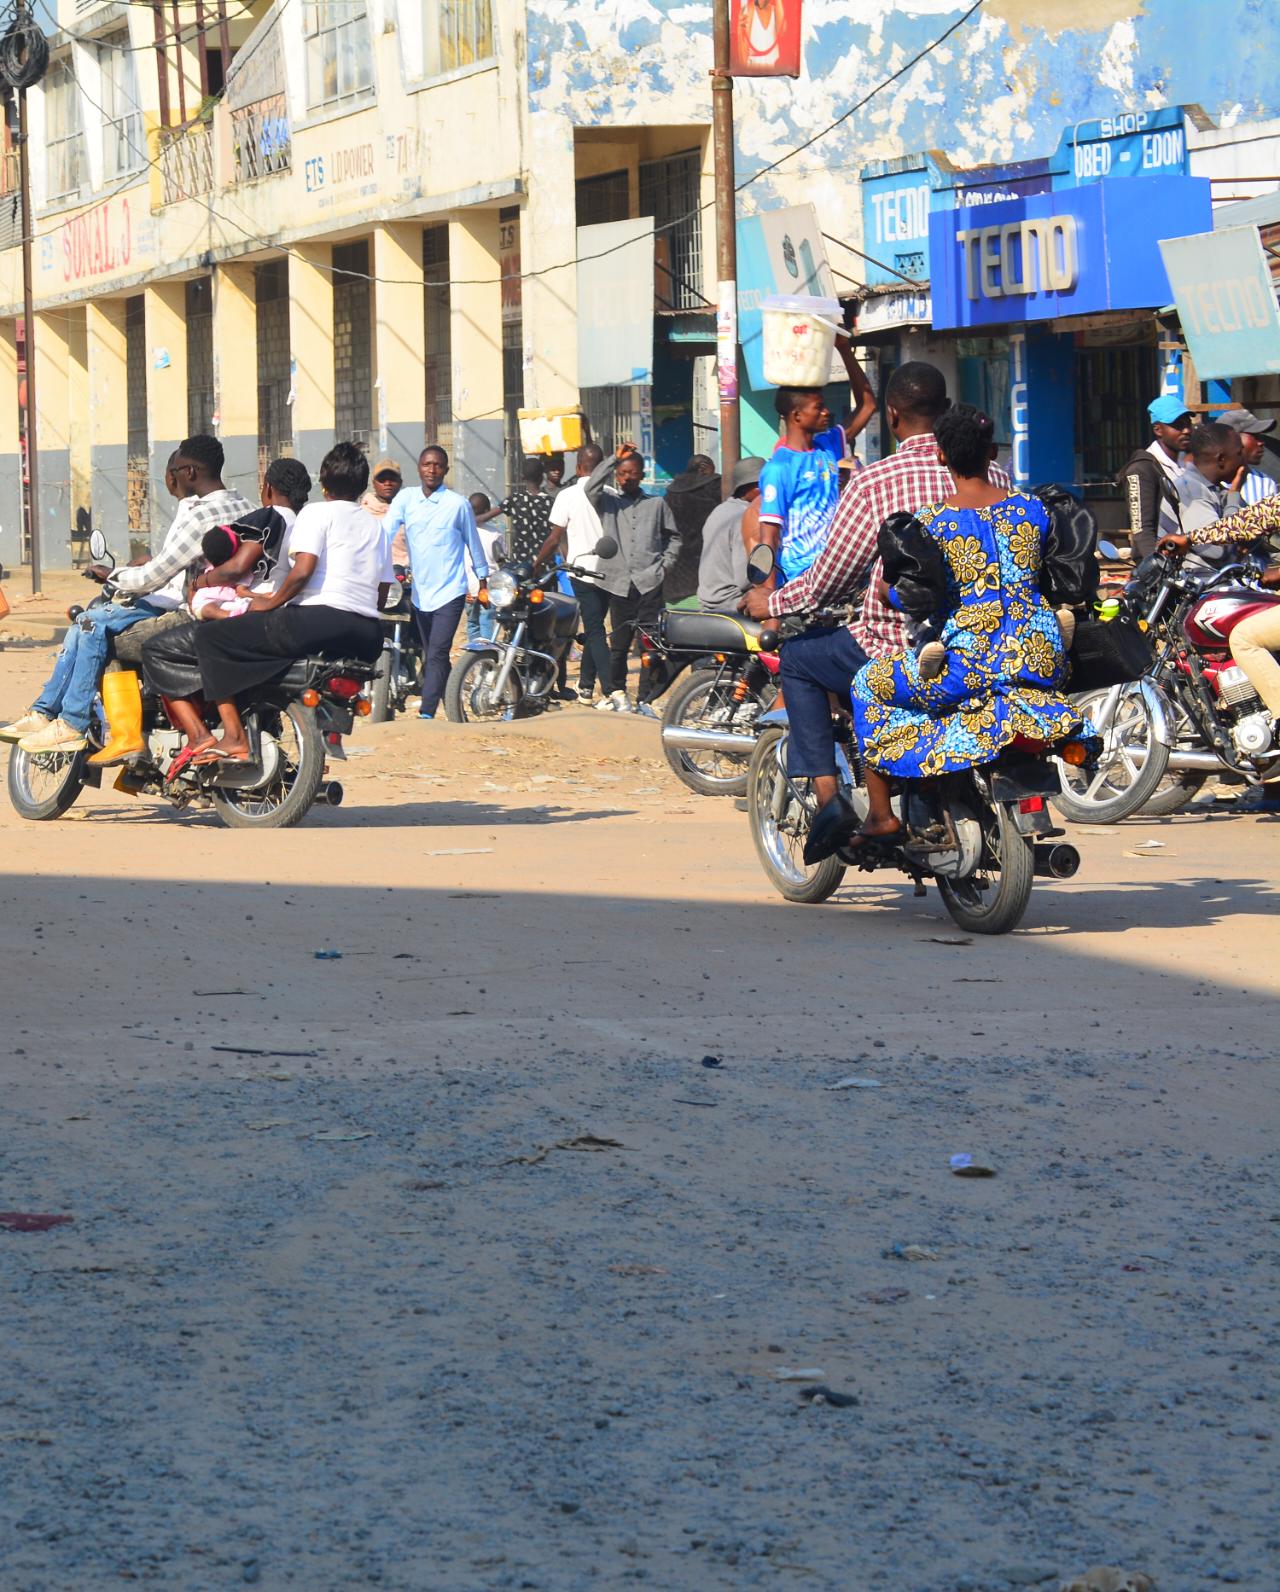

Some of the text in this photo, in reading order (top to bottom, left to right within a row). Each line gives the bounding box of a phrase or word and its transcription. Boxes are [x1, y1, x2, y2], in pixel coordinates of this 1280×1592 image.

[1101, 112, 1148, 138] SHOP
[872, 185, 930, 244] TECNO
[956, 215, 1078, 300] TECNO
[1178, 275, 1269, 336] TECNO
